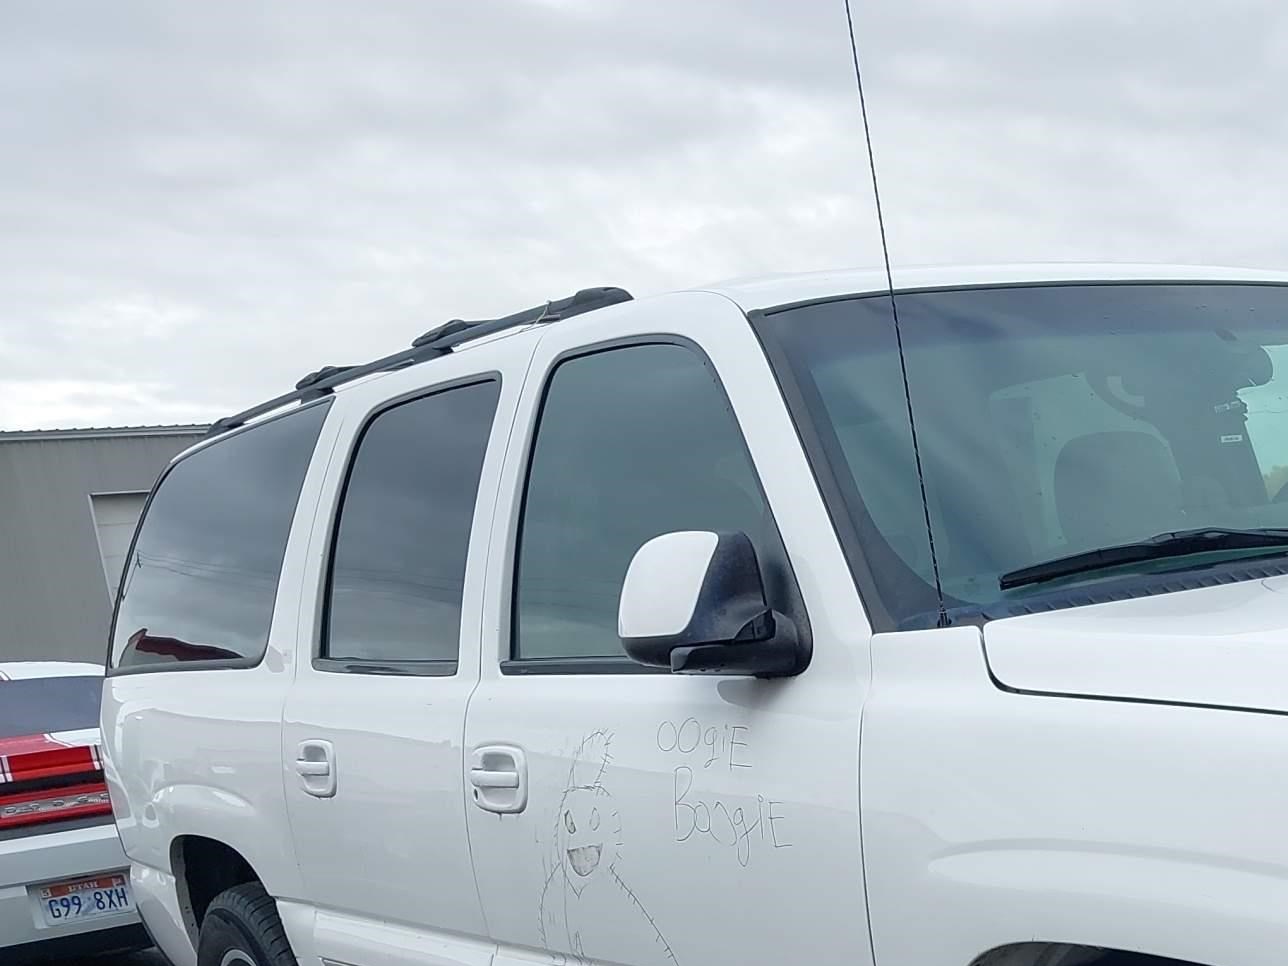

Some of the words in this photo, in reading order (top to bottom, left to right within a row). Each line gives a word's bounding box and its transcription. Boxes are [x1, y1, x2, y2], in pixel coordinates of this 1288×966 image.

[67, 880, 99, 892] UTAH
[48, 895, 82, 919] G99
[93, 887, 129, 910] 8XH
